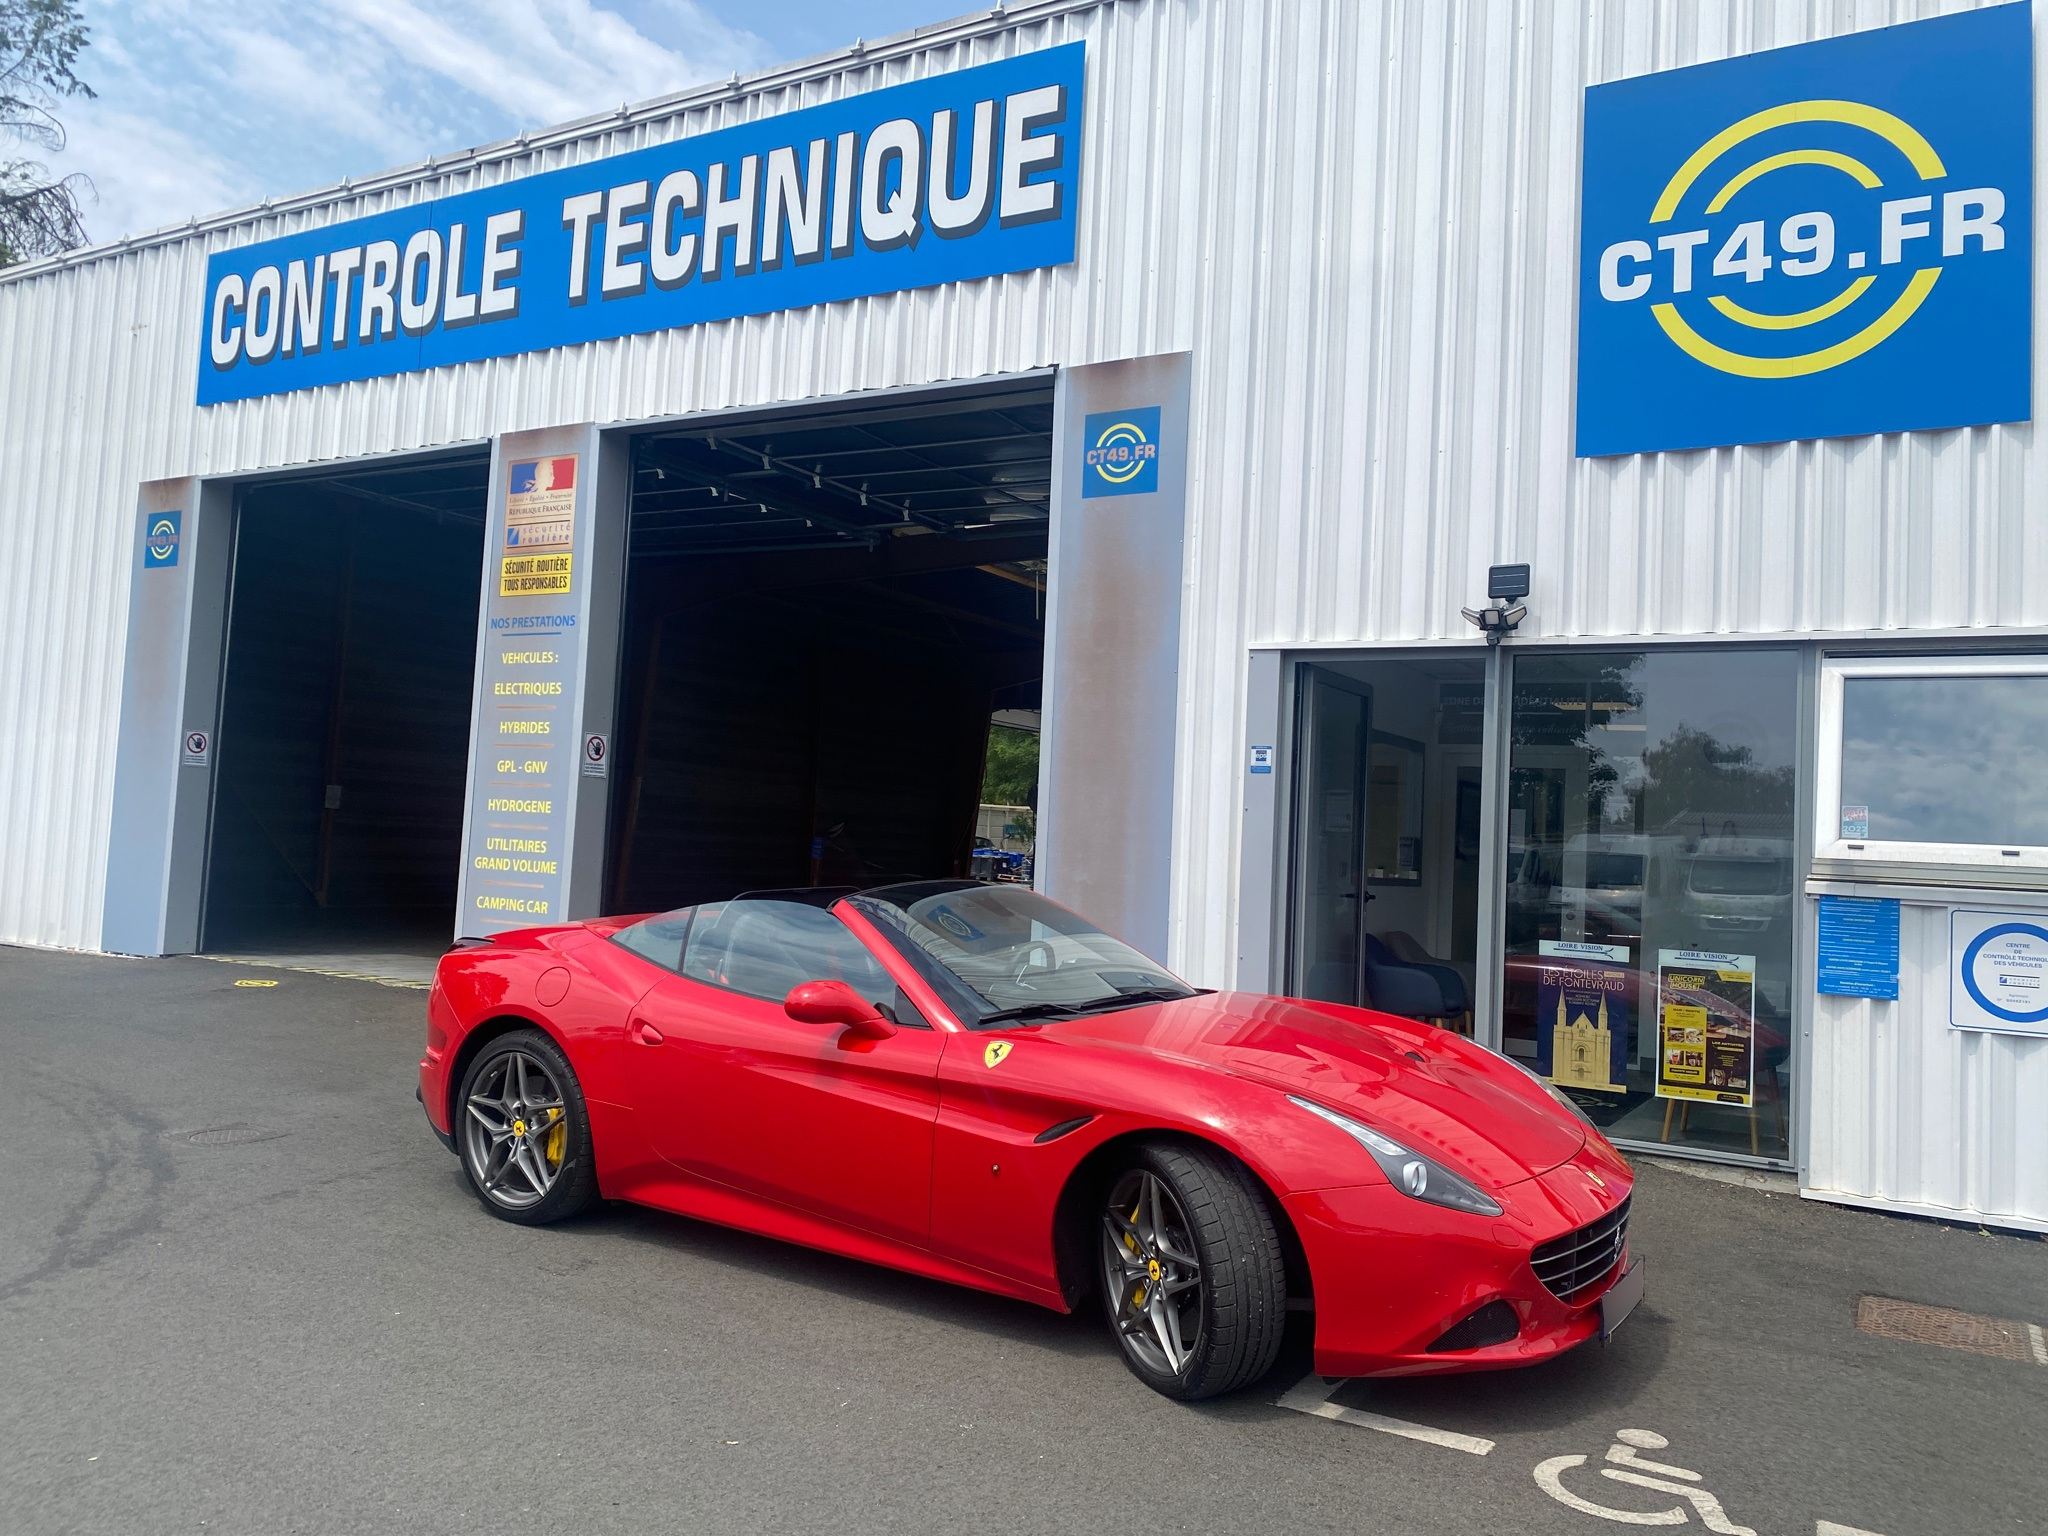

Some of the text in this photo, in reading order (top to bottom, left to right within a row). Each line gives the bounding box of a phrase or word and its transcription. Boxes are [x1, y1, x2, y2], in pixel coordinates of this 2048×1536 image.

[211, 84, 1066, 369] CONTROLE TECHNIQUE
[1600, 187, 2006, 302] CT49.FR
[1086, 444, 1156, 465] CT49.FR
[523, 523, 571, 534] sécurité
[522, 532, 569, 544] routière
[505, 556, 568, 574] SÉCURITÉ ROUTIÈRE
[504, 576, 567, 591] TOUS RESPONSABLES
[490, 615, 576, 629] NOS PRESTATIONS
[502, 652, 553, 664] VEHICULES
[494, 682, 562, 695] ELECTRIQUES
[500, 722, 550, 733] HYBRIDES
[497, 760, 516, 772] GPL
[524, 761, 548, 773] GNV
[488, 799, 552, 813] HYDROGENE
[486, 838, 547, 853] UTILITAIRES
[474, 857, 557, 874] GRAND VOLUME
[476, 896, 548, 914] CAMPING CAR
[1580, 943, 1604, 951] VISION
[2008, 960, 2043, 968] VÉHICULES
[1543, 968, 1560, 977] LES
[1669, 974, 1704, 984] UNICORN
[1543, 976, 1625, 991] DE FONTEVRAUD
[1671, 982, 1698, 990] HOUSE
